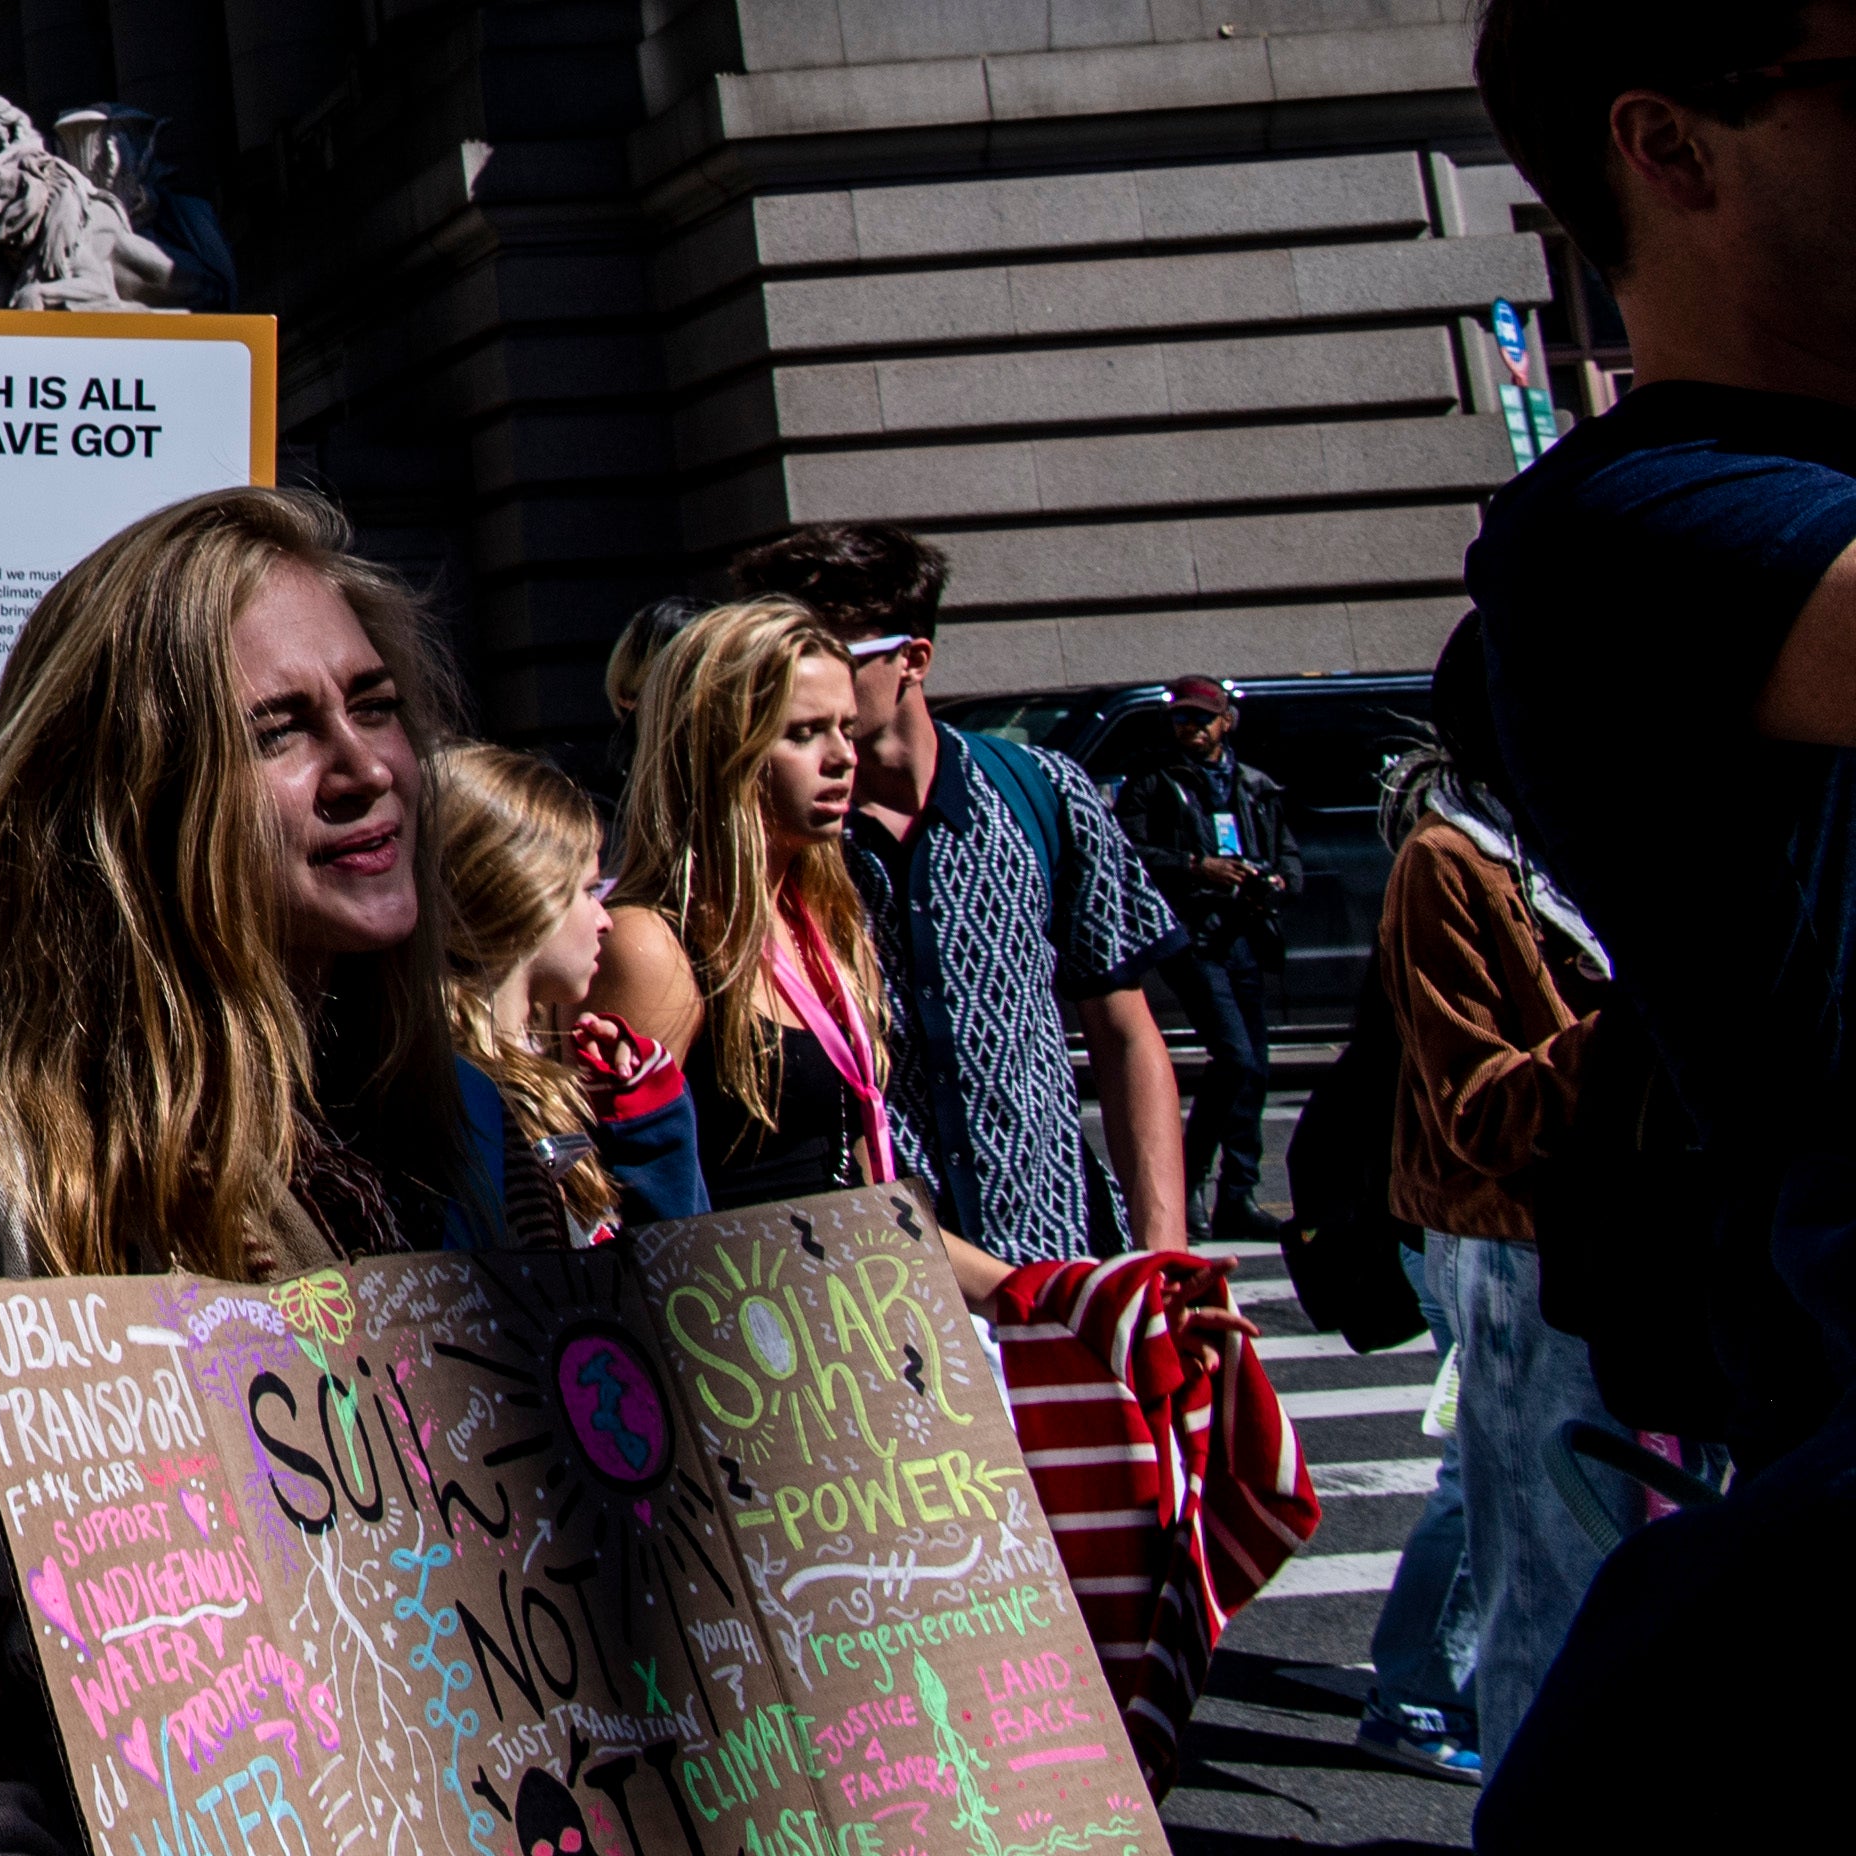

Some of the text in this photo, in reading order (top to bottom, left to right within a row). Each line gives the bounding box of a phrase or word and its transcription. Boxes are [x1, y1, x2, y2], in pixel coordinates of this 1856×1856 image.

[28, 376, 66, 410] IS
[79, 379, 155, 411] ALL
[70, 424, 162, 458] GOT
[7, 571, 25, 580] we
[30, 570, 61, 581] must
[358, 1270, 386, 1312] get
[419, 1265, 450, 1288] in
[408, 1294, 440, 1322] the
[666, 1254, 974, 1459] SOLAR
[82, 1460, 144, 1503] CARS
[774, 1448, 998, 1550] POWER
[1007, 1487, 1032, 1529] &
[54, 1501, 171, 1567] SUPPORT
[984, 1536, 1058, 1582] WIND
[76, 1535, 262, 1640] INDIGENOUS
[455, 1558, 622, 1721] NOT
[688, 1618, 762, 1665] YOUTH
[808, 1585, 1050, 1693] regenerative
[71, 1627, 214, 1739] WATER
[978, 1652, 1071, 1702] LAND
[167, 1635, 340, 1774] PROTECTORS
[991, 1698, 1090, 1744] BACK
[488, 1694, 701, 1780] JUST TRANSITION
[816, 1695, 917, 1765] JUSTICE
[863, 1736, 886, 1763] 4
[683, 1703, 827, 1822] CLIMATE
[840, 1754, 958, 1808] FARMERS
